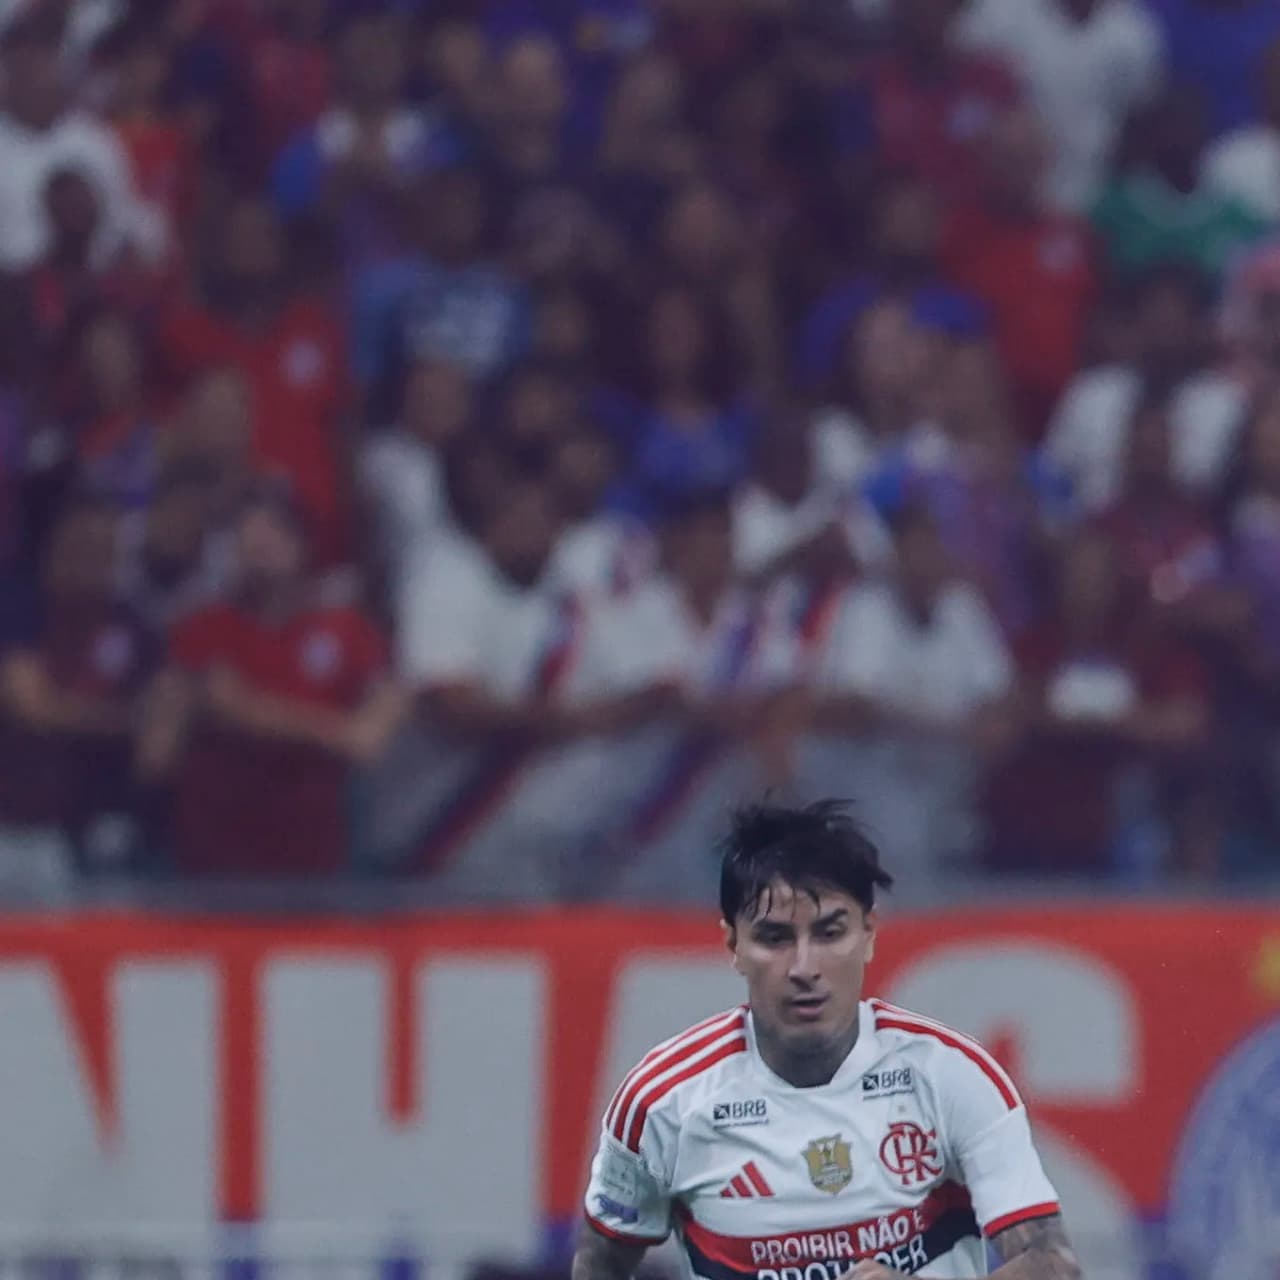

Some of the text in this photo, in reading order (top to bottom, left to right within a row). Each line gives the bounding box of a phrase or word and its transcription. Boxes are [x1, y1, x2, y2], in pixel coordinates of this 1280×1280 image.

[732, 1099, 767, 1119] BRB
[751, 1230, 854, 1265] PROIBIR
[857, 1214, 909, 1253] NÃO
